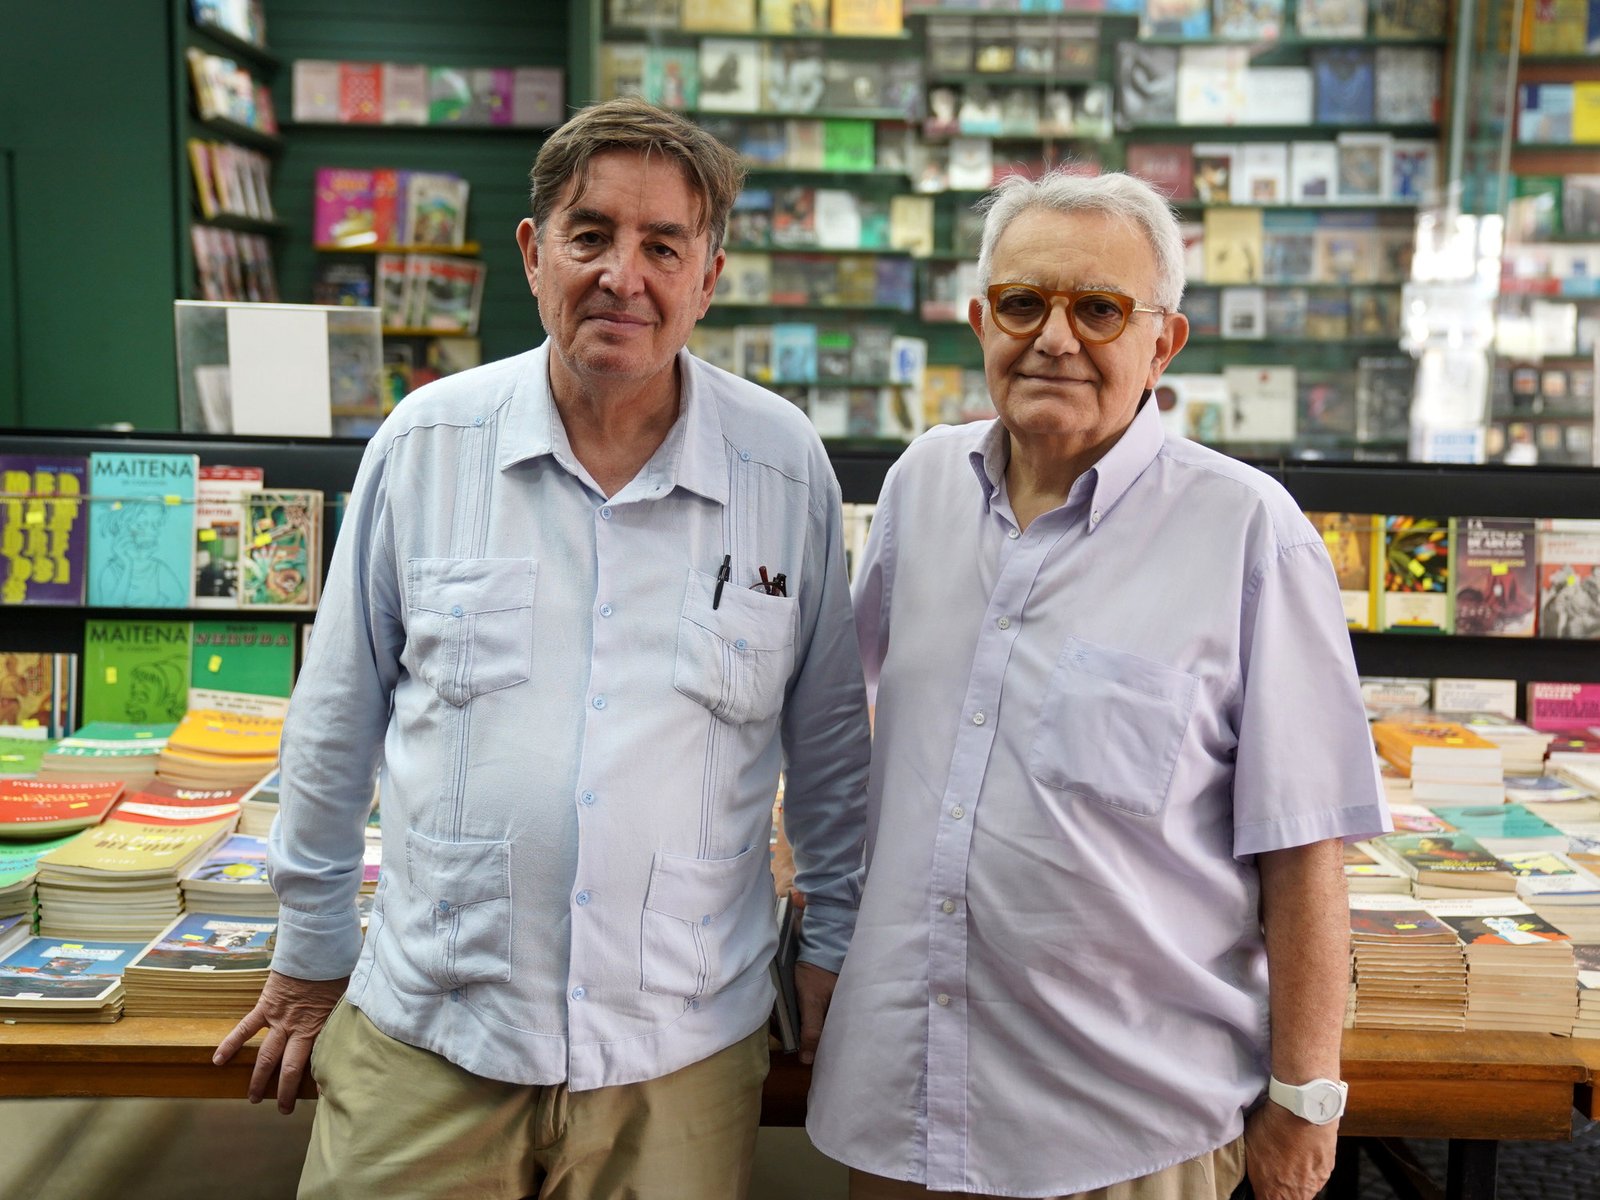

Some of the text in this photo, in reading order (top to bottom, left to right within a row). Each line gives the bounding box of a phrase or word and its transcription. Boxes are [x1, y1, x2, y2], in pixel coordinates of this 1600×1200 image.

[95, 461, 193, 478] MAITENA
[89, 624, 188, 645] MAITENA
[194, 631, 289, 646] NERUDA
